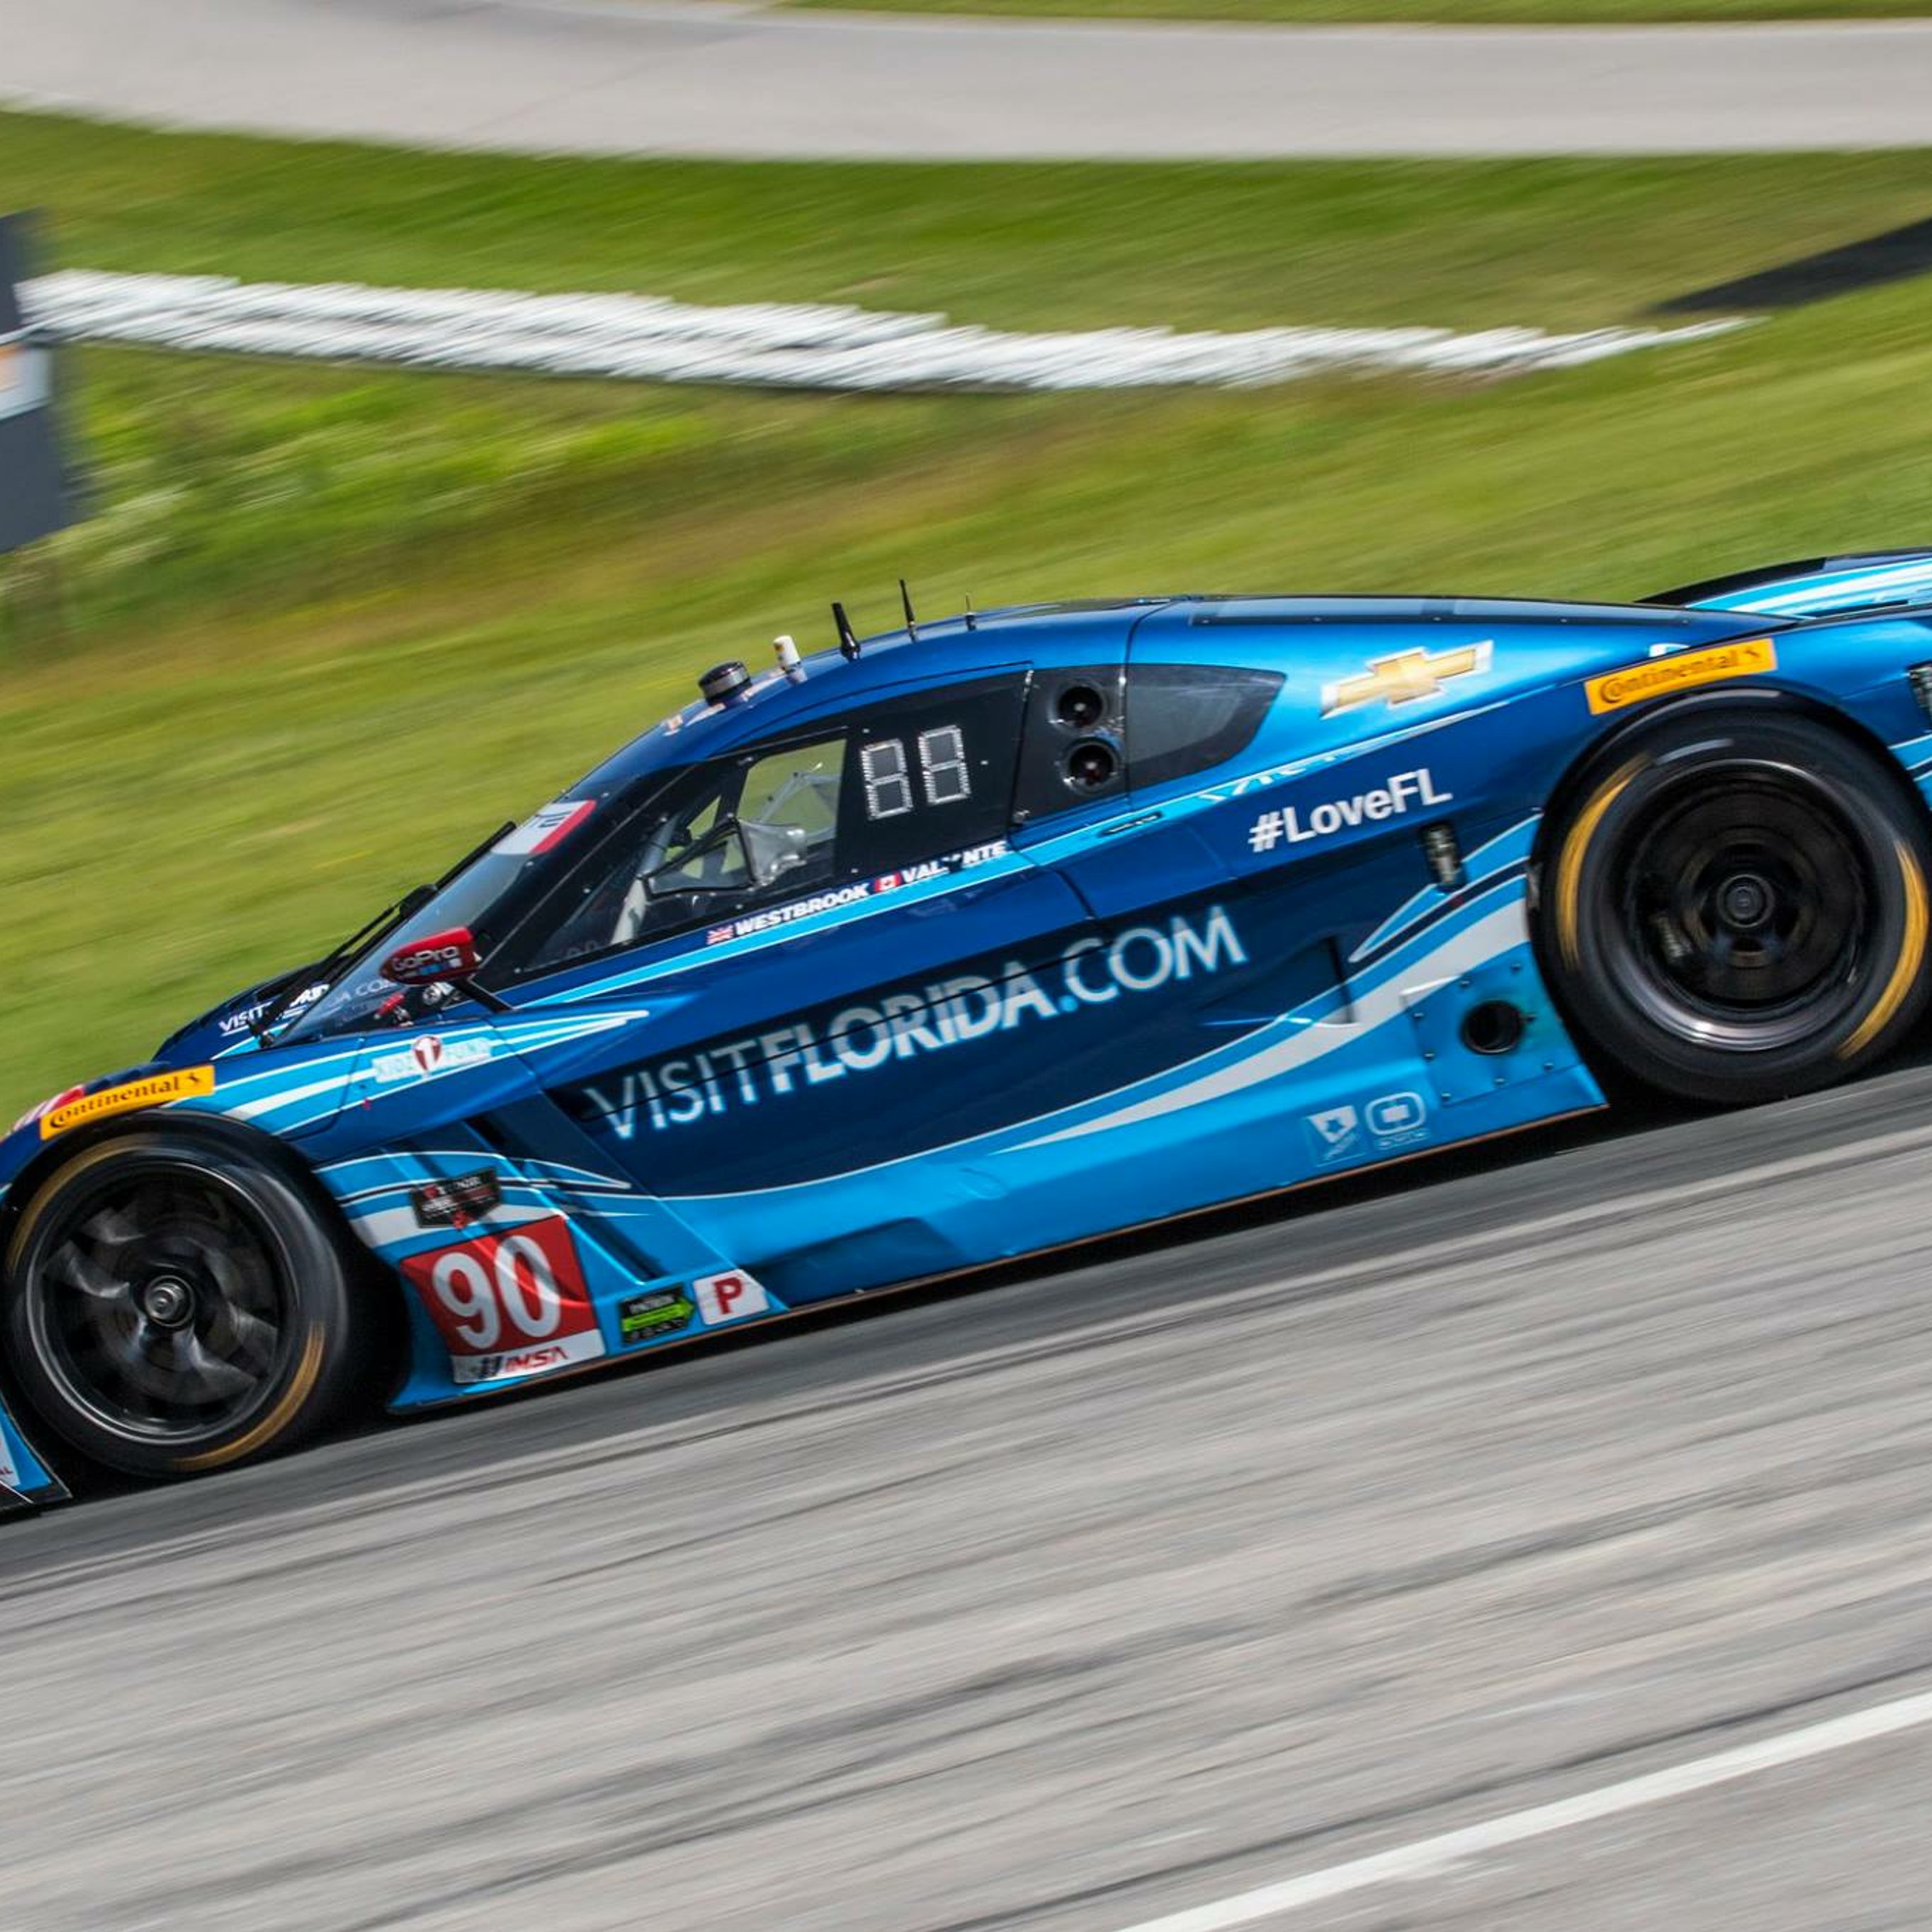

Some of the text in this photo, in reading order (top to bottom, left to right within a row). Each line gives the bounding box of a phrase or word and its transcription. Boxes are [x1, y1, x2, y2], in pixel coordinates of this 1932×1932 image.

[1600, 649, 1738, 703] Continental
[1247, 768, 1454, 853] #LoveFL
[734, 840, 1007, 936] WESTBROOK VALNTE
[393, 945, 460, 971] GoPro
[583, 905, 1248, 1141] VISITFLORIDA.COM
[50, 1076, 180, 1128] Continental
[431, 1235, 562, 1350] 90
[712, 1277, 743, 1314] P
